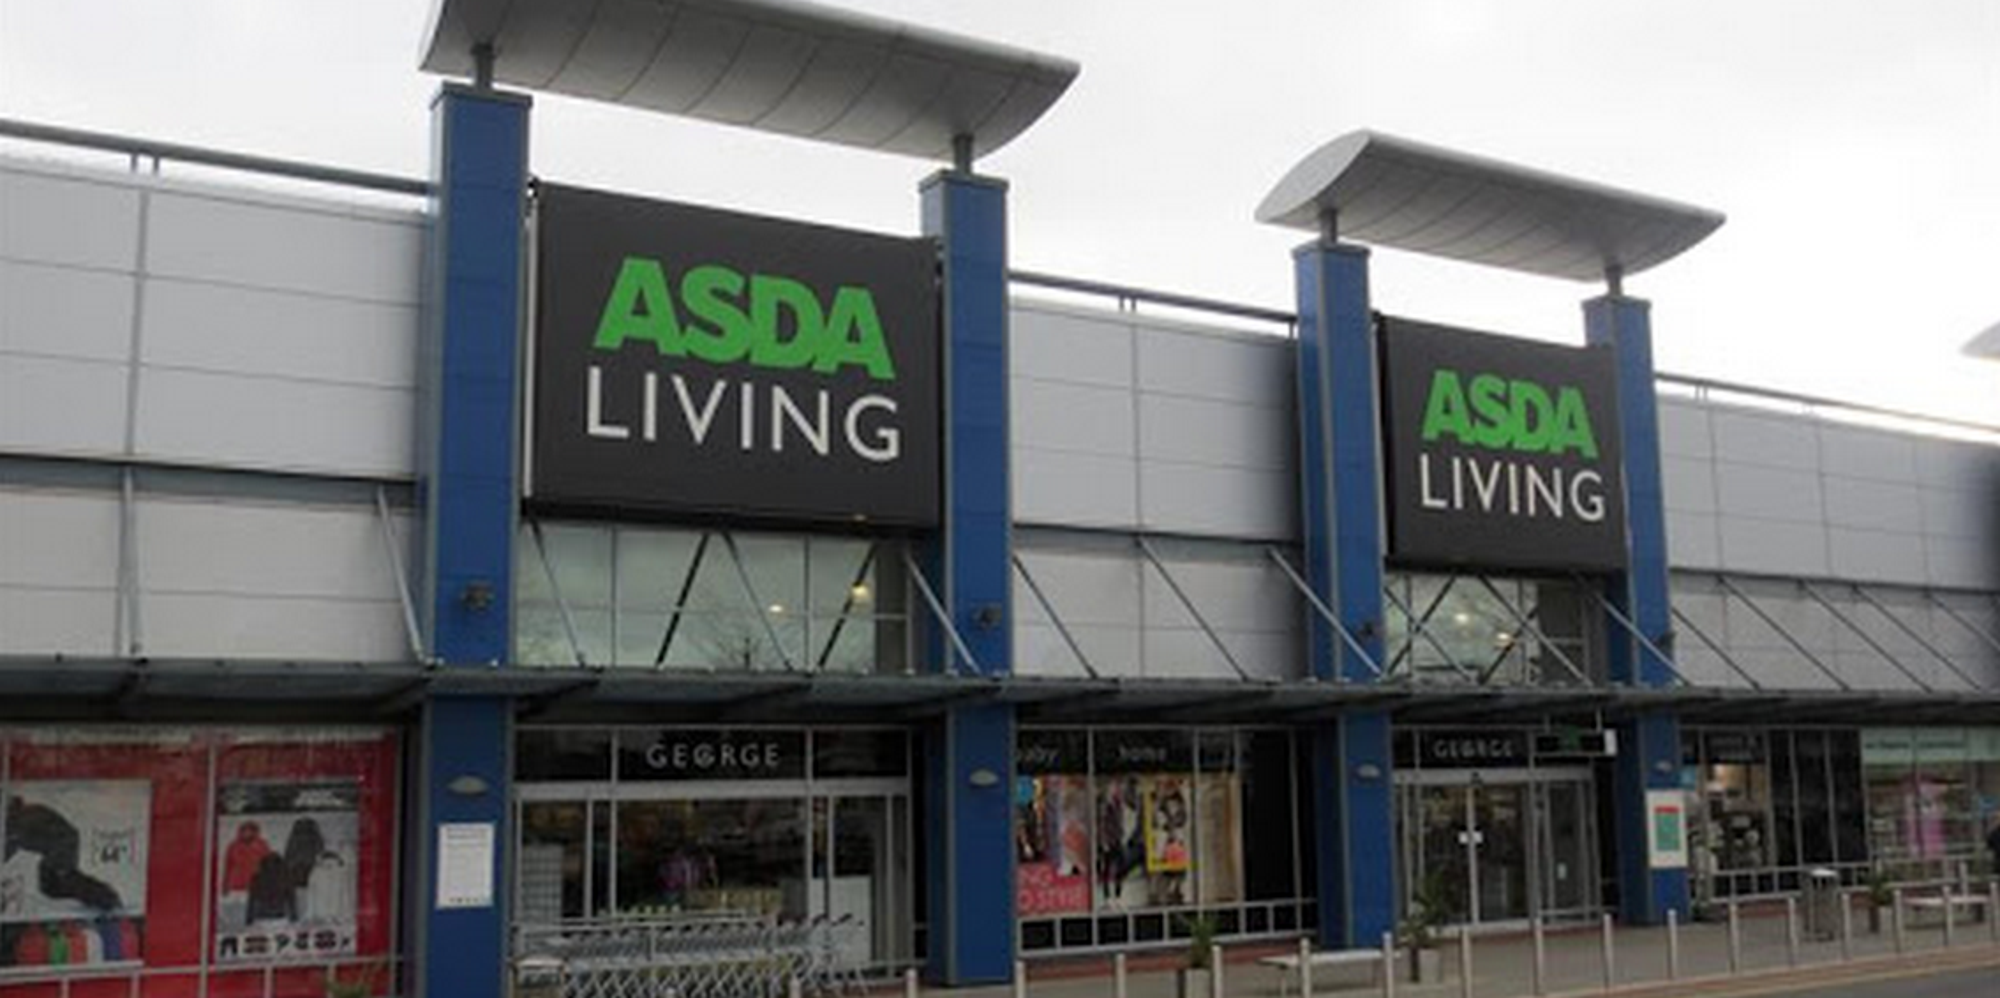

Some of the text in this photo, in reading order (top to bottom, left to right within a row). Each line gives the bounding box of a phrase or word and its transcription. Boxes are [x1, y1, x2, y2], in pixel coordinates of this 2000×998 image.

[594, 258, 895, 379] ASDA
[587, 366, 900, 461] LIVING
[1422, 370, 1598, 458] ASDA
[1420, 453, 1604, 522] LIVING
[645, 742, 780, 769] GEORGE
